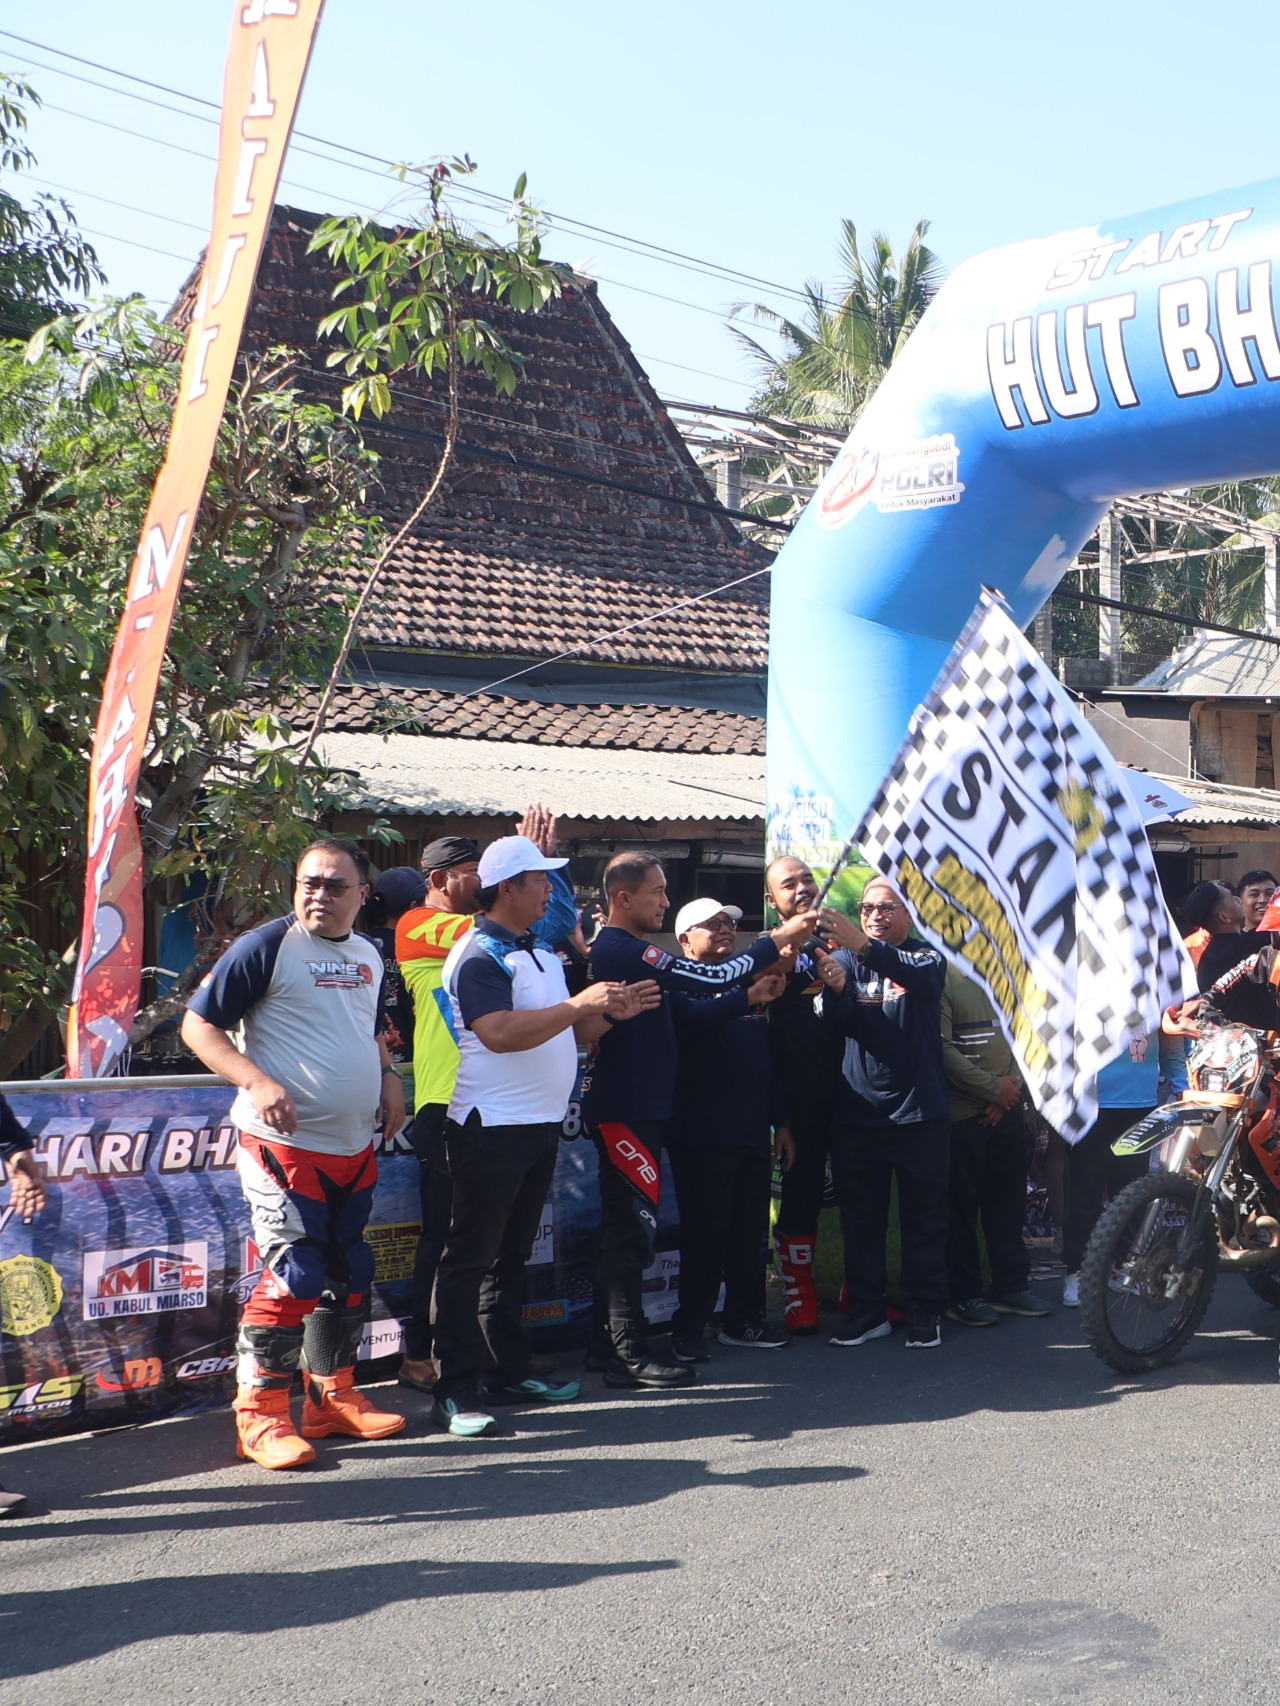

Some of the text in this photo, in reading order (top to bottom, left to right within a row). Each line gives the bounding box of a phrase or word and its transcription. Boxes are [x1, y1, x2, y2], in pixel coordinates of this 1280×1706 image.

[1045, 208, 1256, 291] START
[986, 295, 1140, 430] HUT
[880, 460, 955, 493] POLRI
[881, 493, 956, 510] Untuk Masyarakat
[33, 1131, 151, 1178] HARI
[98, 1259, 151, 1298] KM
[88, 1291, 205, 1318] UD. KABUL MIARSO
